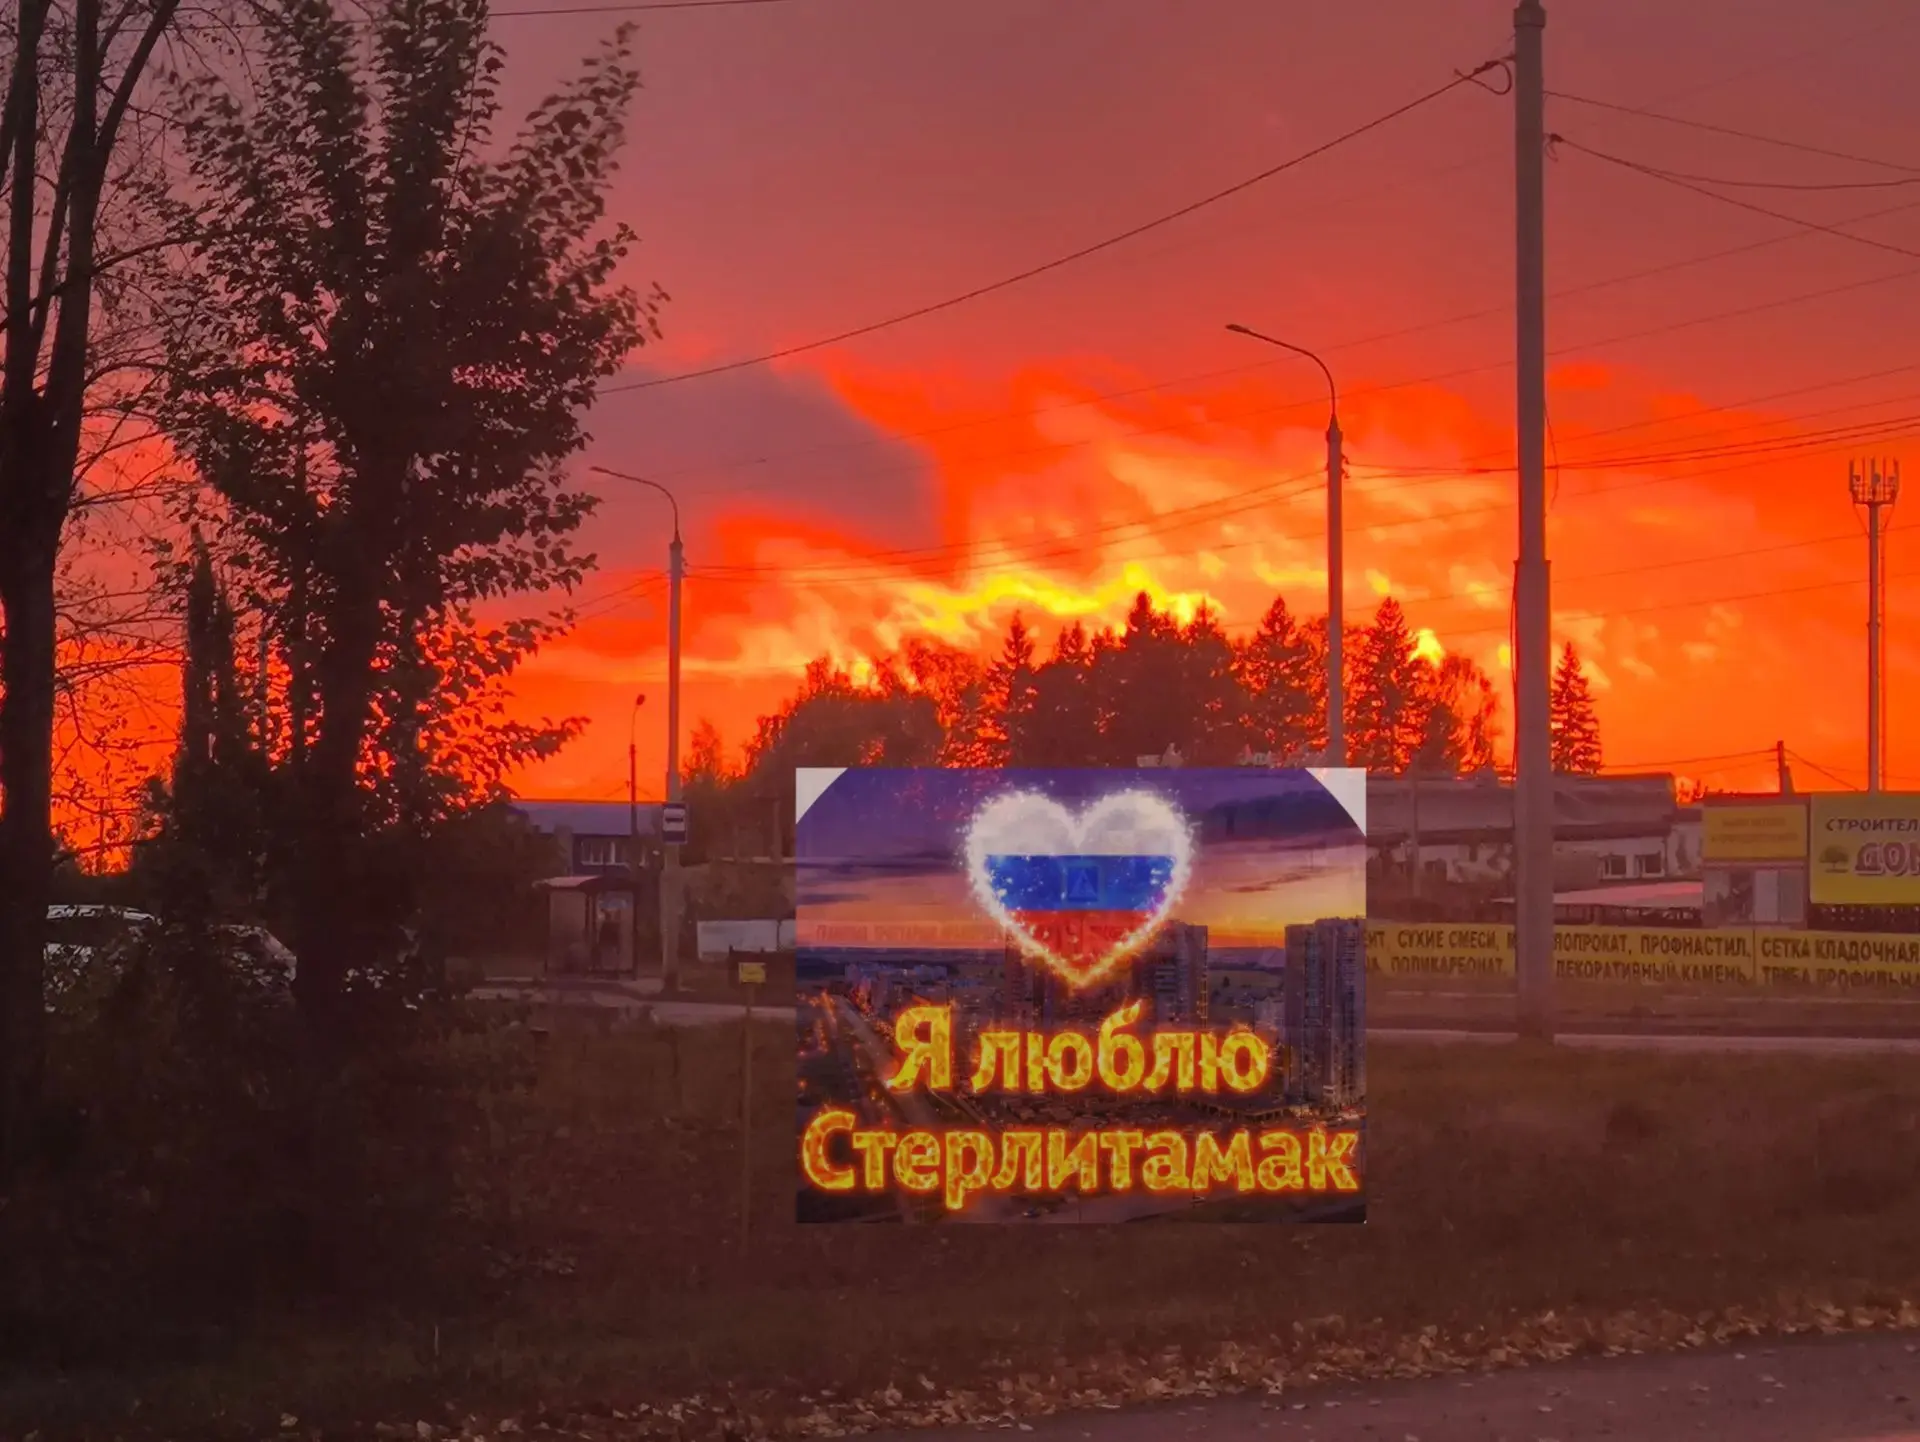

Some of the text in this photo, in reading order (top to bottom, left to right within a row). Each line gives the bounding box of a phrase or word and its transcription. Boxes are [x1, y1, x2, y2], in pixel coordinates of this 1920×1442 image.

[1398, 929, 1444, 949] СУХИЕ
[1761, 937, 1810, 958] СЕТКА
[1815, 939, 1919, 964] КЛАДОЧНАЯ
